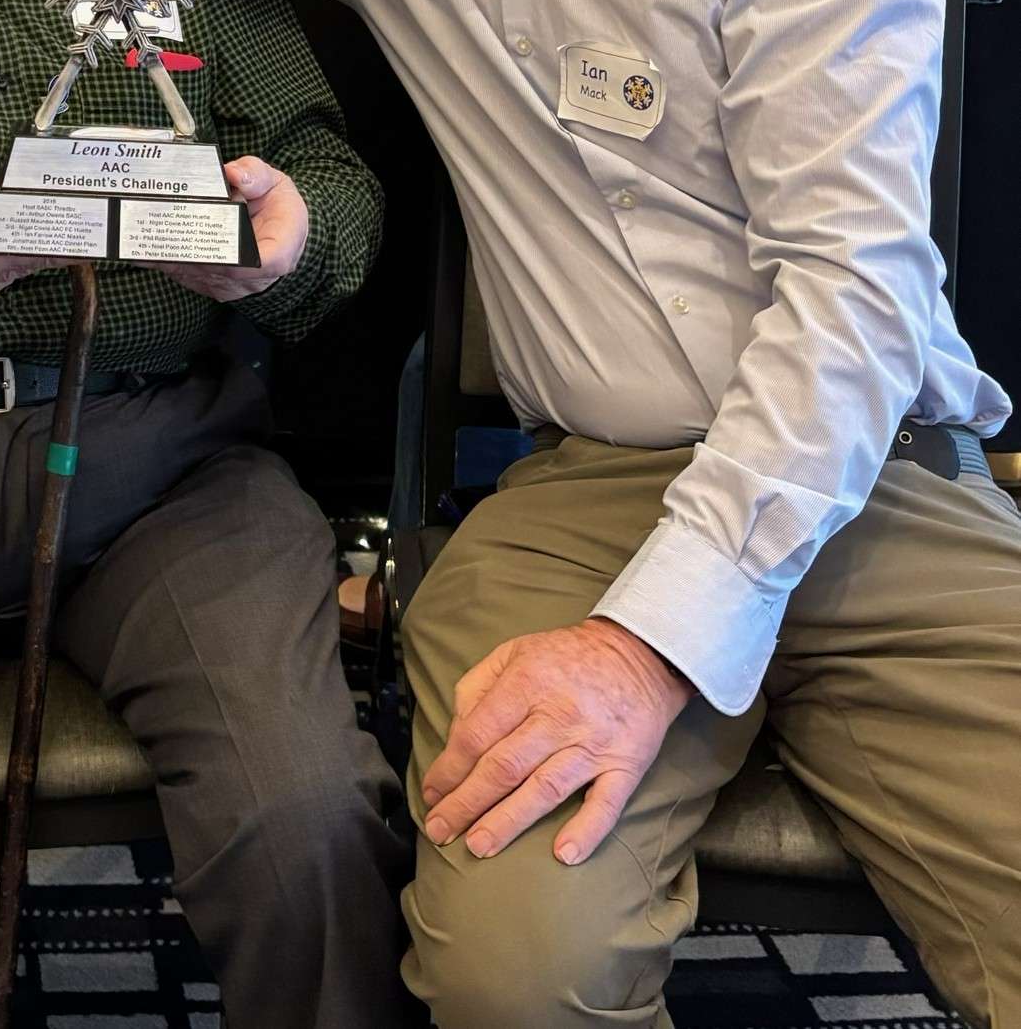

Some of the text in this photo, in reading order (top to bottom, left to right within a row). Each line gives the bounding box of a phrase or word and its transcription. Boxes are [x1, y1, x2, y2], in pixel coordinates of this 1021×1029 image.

[581, 60, 608, 82] Ian
[580, 85, 607, 101] Mack
[71, 142, 162, 159] Leon Smith
[101, 162, 130, 173] AAC
[43, 174, 188, 192] President's Challenge
